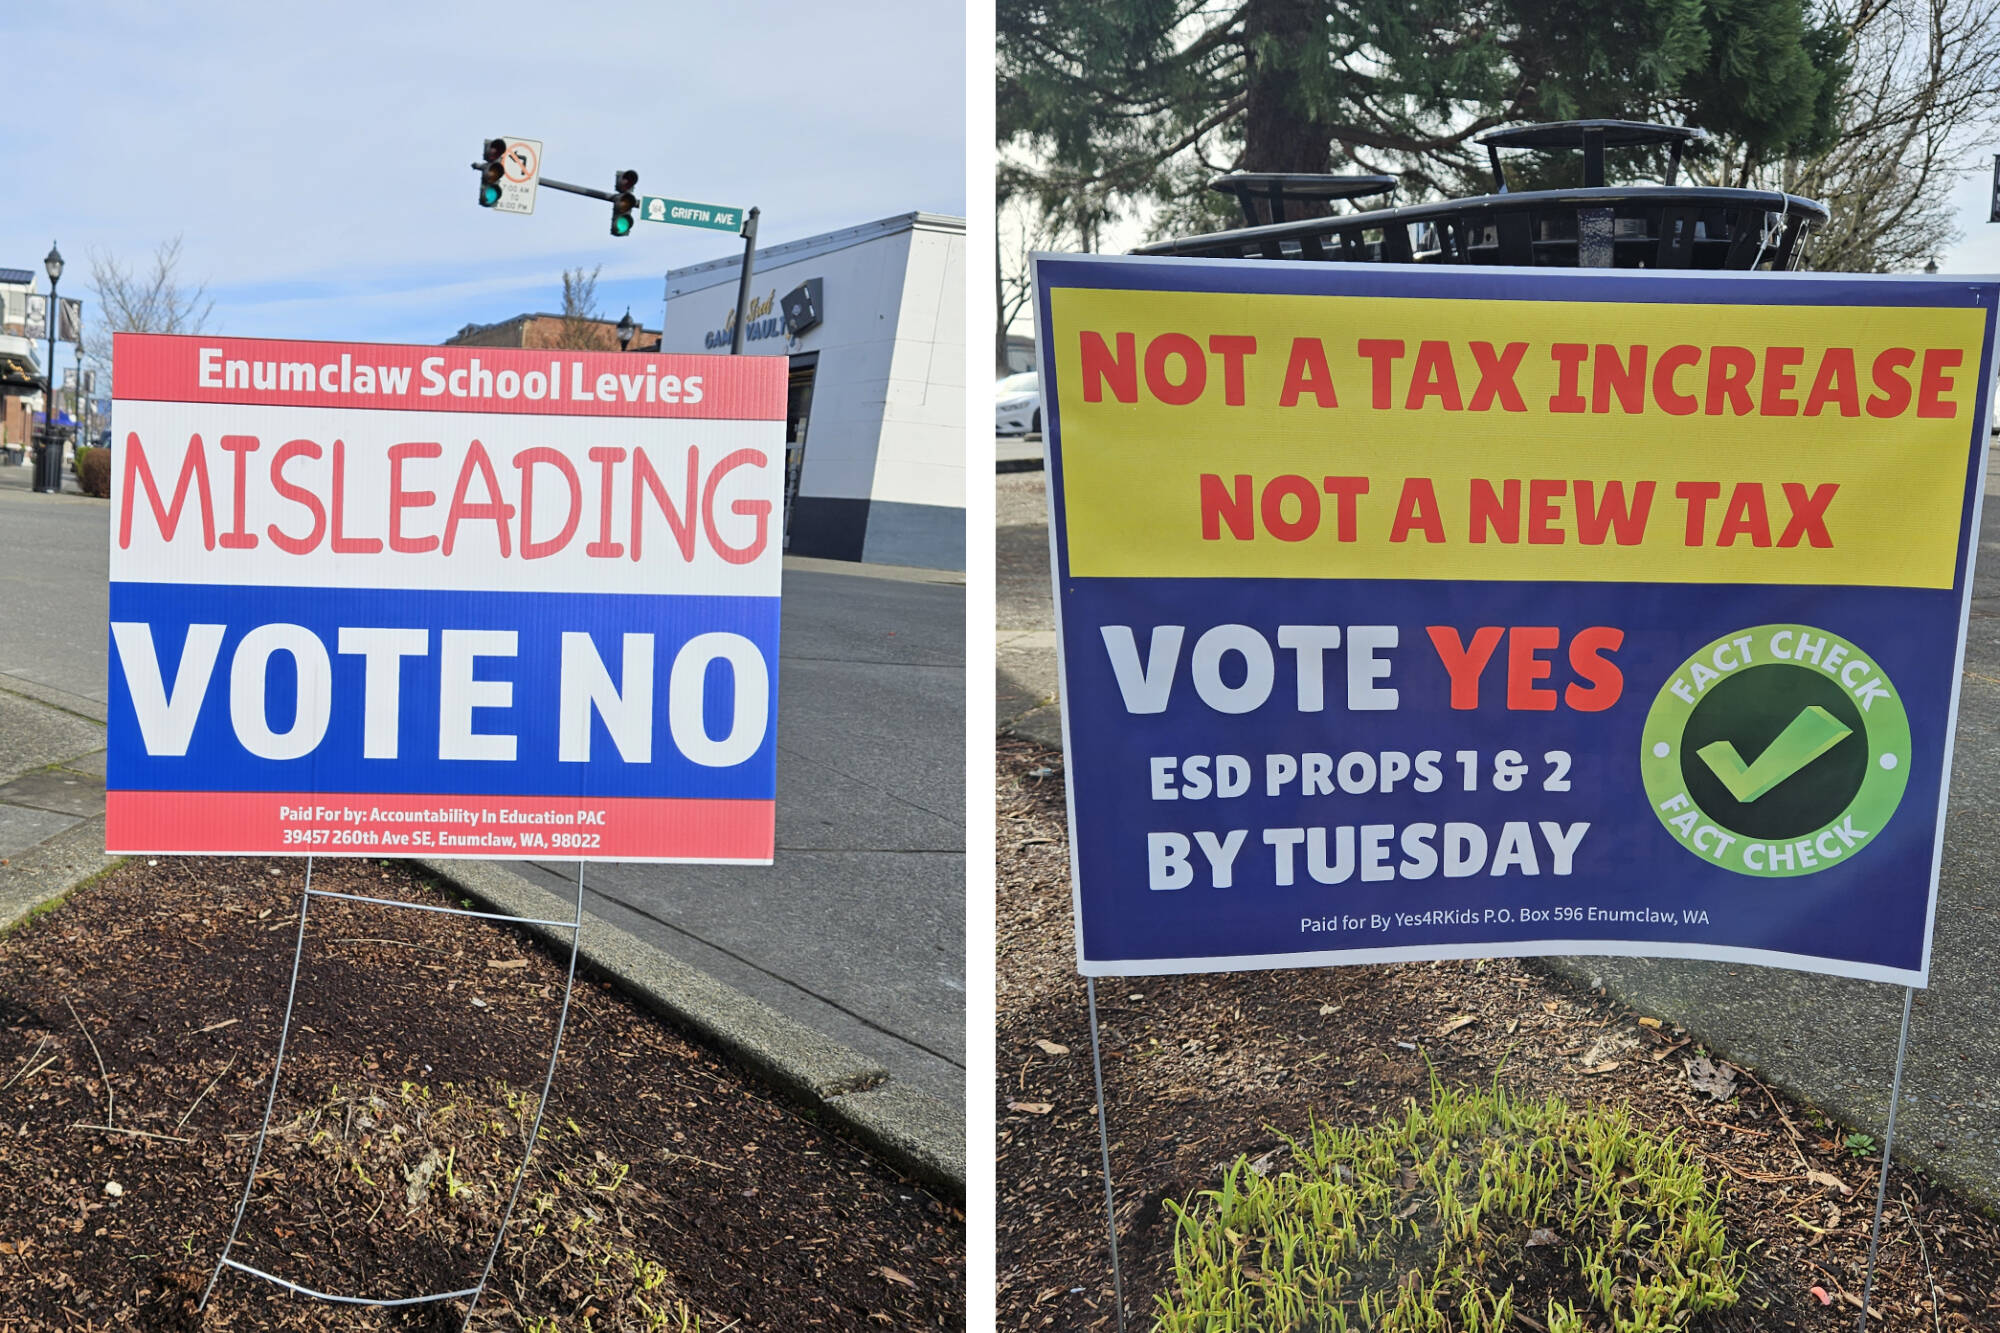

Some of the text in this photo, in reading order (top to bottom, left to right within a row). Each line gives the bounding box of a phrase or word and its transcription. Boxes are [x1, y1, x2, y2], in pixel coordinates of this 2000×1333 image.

[671, 206, 711, 222] GRIFFIN
[199, 348, 703, 403] Enumclaw School Levies
[1080, 332, 1963, 418] NOT A TAX INCREASE
[120, 432, 771, 564] MISLEADING
[1200, 474, 1840, 548] NOT A NEW TAX
[111, 622, 768, 767] VOTE NO
[1100, 624, 1624, 714] VOTE YES
[1670, 630, 1892, 713] FACT CHECK
[1151, 750, 1571, 800] ESD PROPS 1 & 2
[279, 805, 606, 827] Paid For by: Accountability In Education PAC
[282, 828, 601, 850] 39457 260th Ave SE, Enumclaw, WA, 98022
[1659, 793, 1870, 872] FACT CHECK
[1148, 822, 1590, 890] BY TUESDAY
[1301, 906, 1710, 933] Paid for By Yes4RKids P.O. Box 596 Enumclaw, WA
